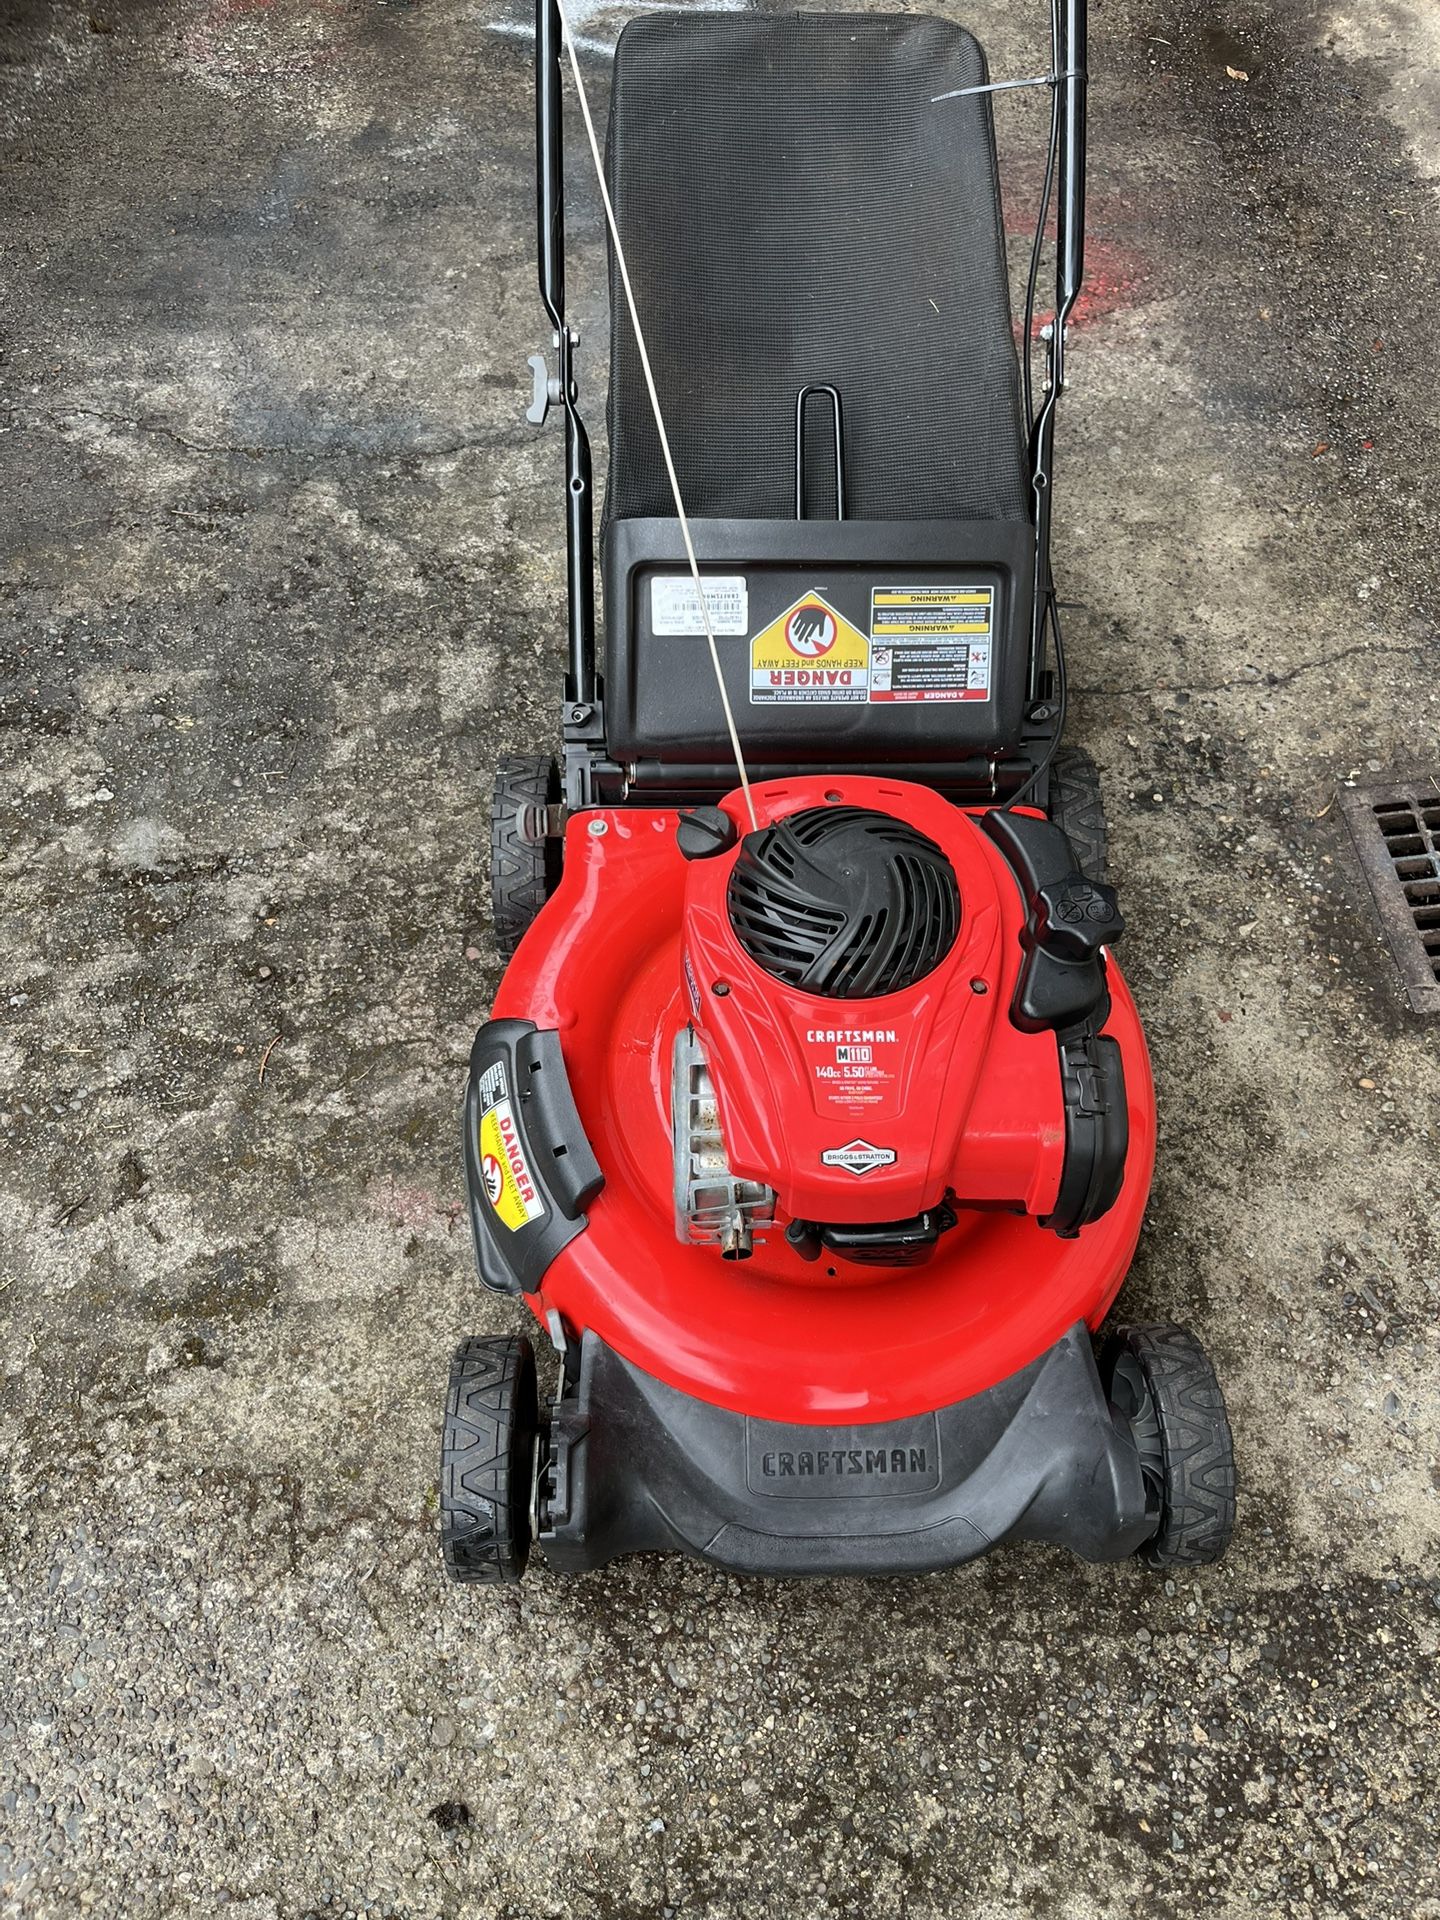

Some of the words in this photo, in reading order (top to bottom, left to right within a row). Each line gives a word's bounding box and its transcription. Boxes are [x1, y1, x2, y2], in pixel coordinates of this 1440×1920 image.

[844, 660, 863, 668] KEEP
[770, 671, 852, 685] DANGER
[807, 1031, 896, 1042] CRAFTSMAN
[838, 1048, 870, 1061] M110
[816, 1066, 841, 1078] 140cc
[844, 1067, 864, 1077] 5.50
[490, 1114, 499, 1132] KEEP
[493, 1132, 506, 1161] HANDS
[499, 1116, 535, 1204] DANGER
[501, 1161, 510, 1175] and
[506, 1175, 517, 1194] FEET
[513, 1193, 527, 1219] AWAY
[762, 1448, 927, 1477] CRAFTSMAN
